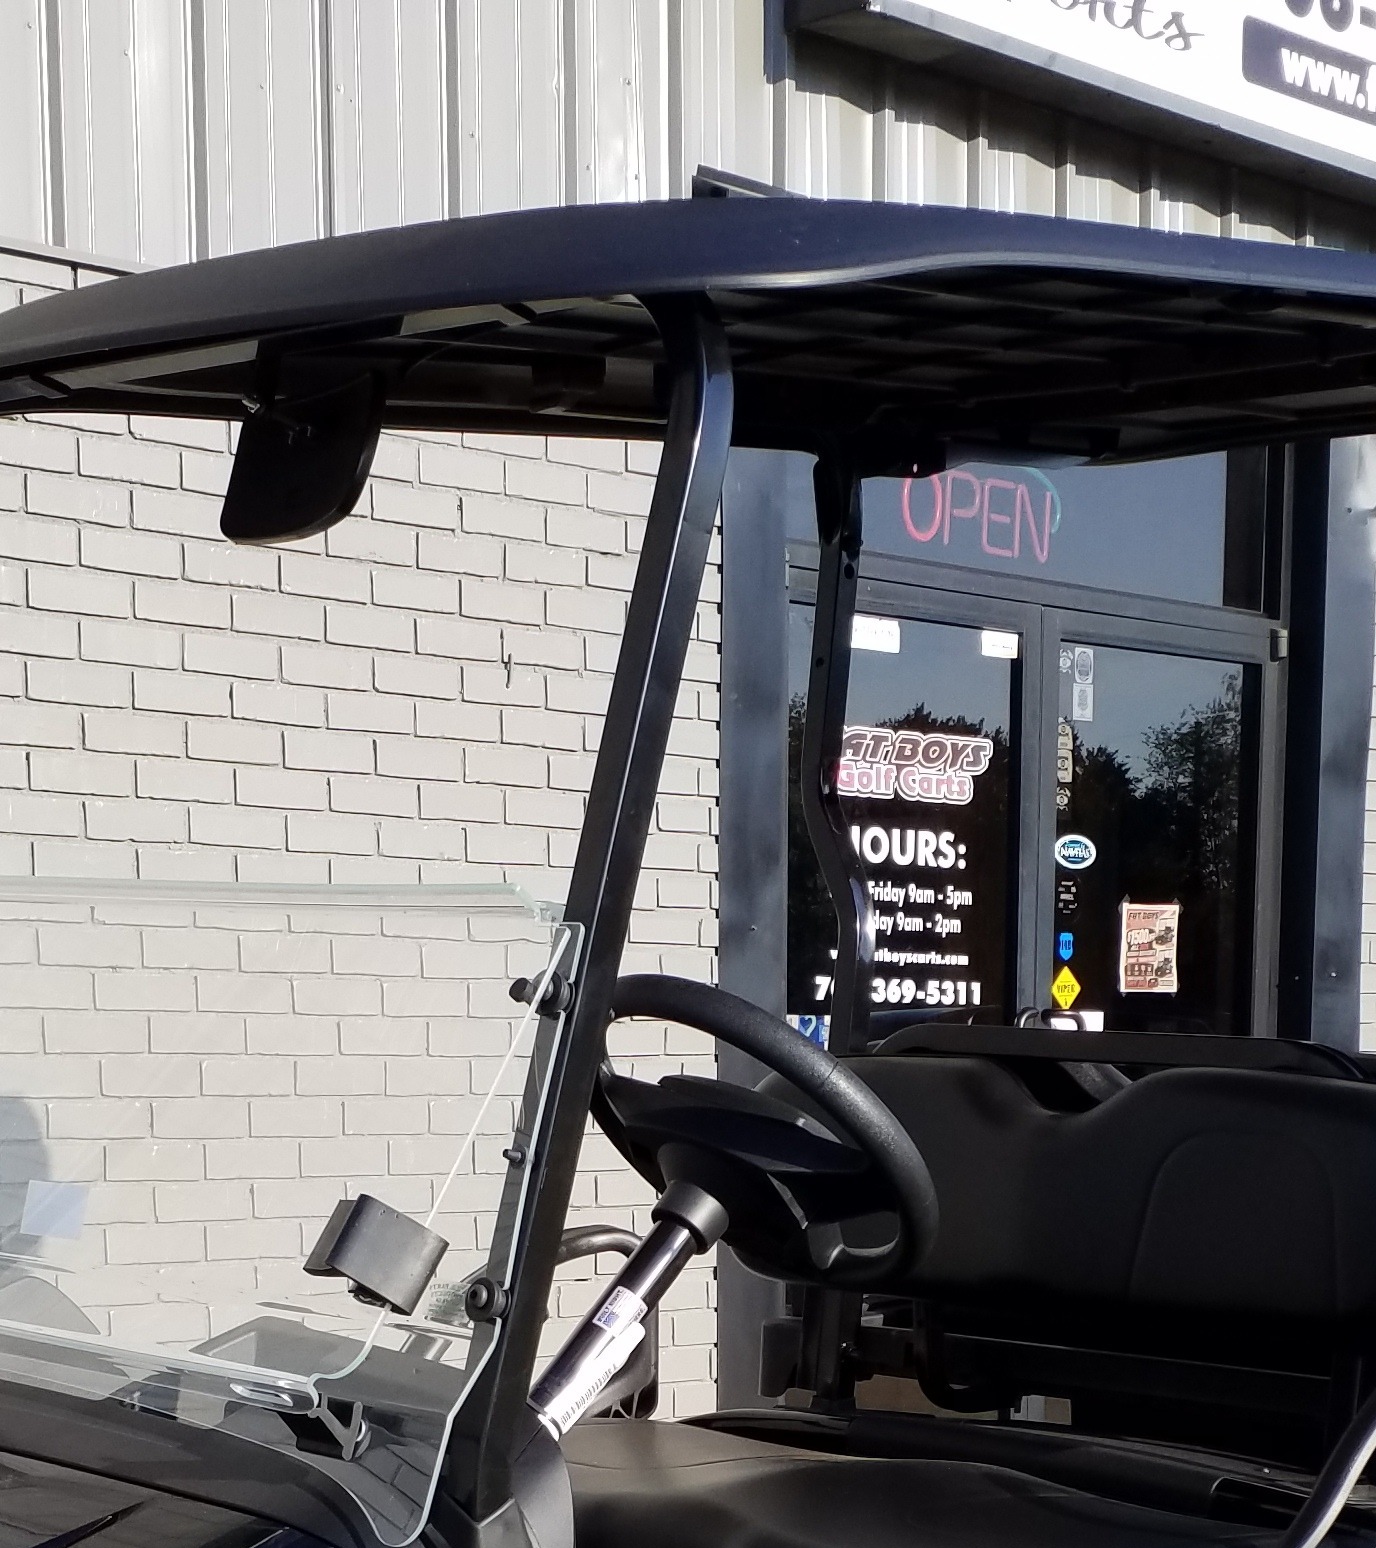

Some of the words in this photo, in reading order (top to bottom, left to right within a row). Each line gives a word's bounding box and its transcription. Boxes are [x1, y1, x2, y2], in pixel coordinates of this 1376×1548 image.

[901, 468, 1053, 565] OPEN
[842, 732, 892, 763] AT
[892, 736, 989, 771] BOYS
[838, 762, 895, 790] Golf
[901, 768, 968, 798] Carts
[867, 881, 906, 908] Friday
[908, 883, 935, 905] 9am
[946, 885, 973, 910] 5pm
[874, 909, 895, 936] day
[896, 911, 924, 932] 9am
[934, 913, 962, 939] 2pm
